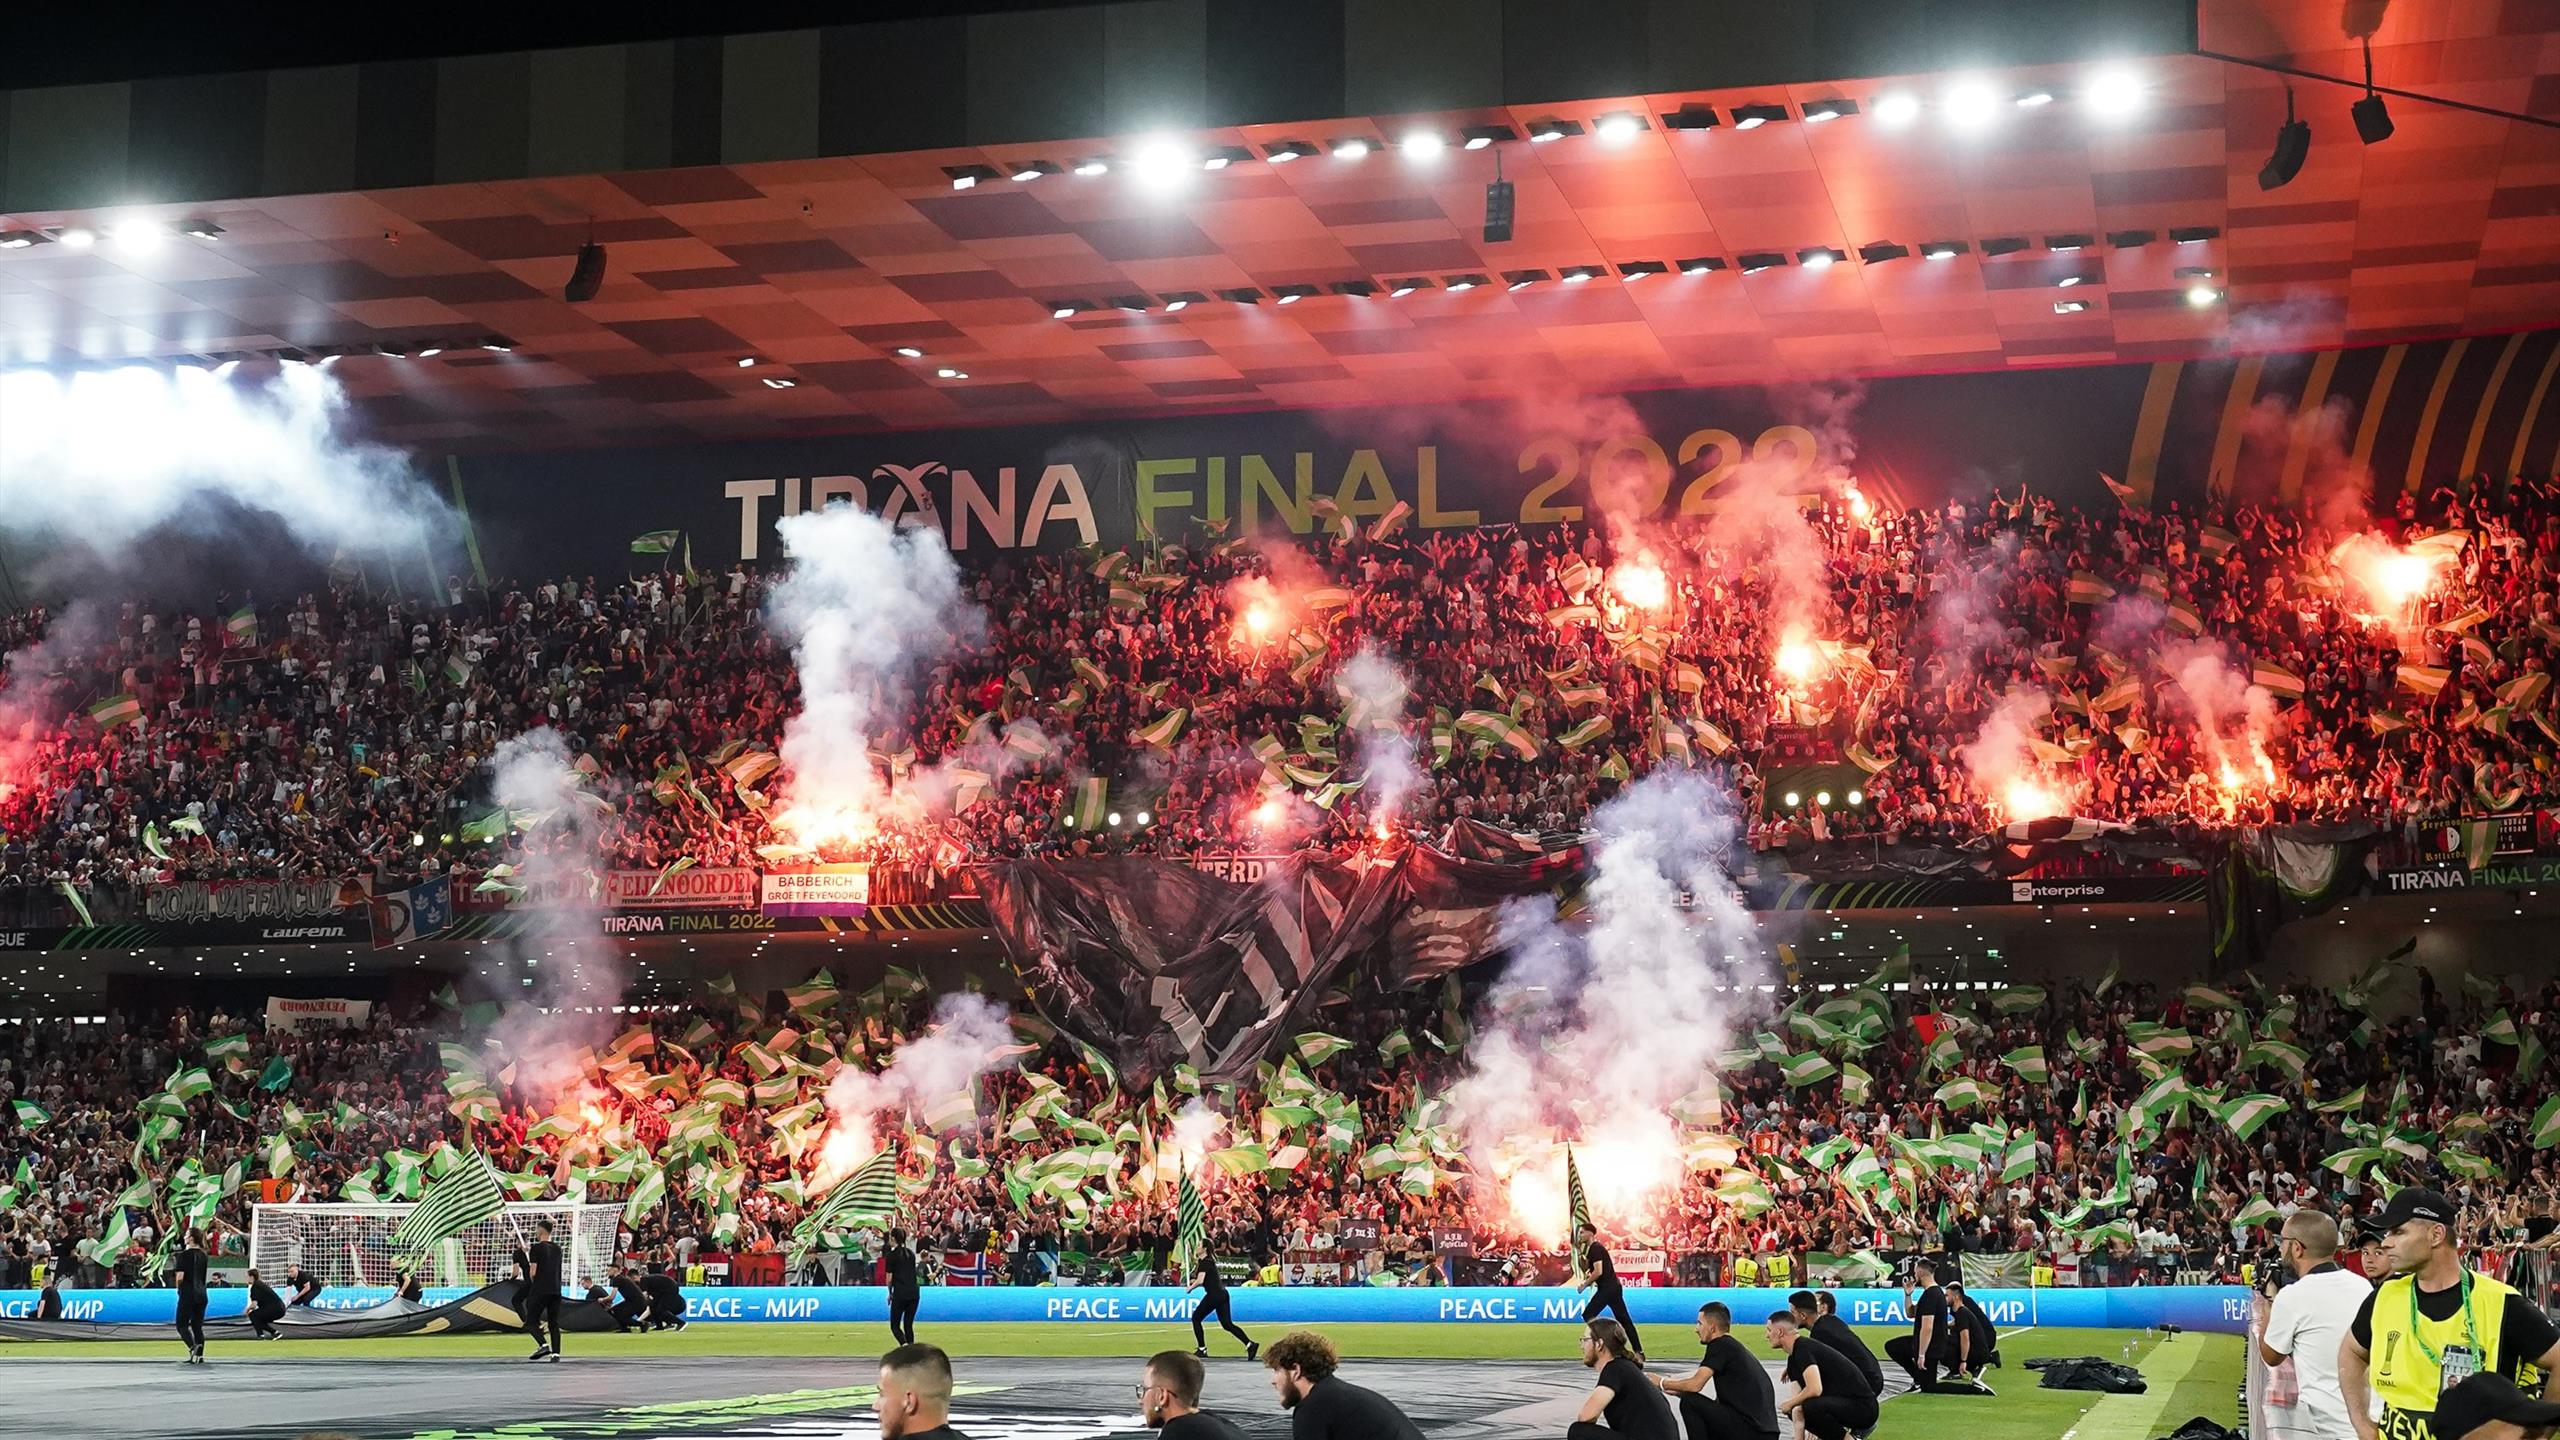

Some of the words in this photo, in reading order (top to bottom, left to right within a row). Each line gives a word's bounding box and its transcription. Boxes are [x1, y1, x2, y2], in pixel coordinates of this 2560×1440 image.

[1136, 446, 1480, 542] FINAL
[1518, 425, 1822, 524] 2022
[2421, 818, 2466, 830] Feyenoo
[2425, 851, 2466, 862] Rotterda
[778, 876, 853, 887] BABBERICH
[2388, 870, 2465, 890] TIRANA
[2471, 866, 2537, 886] FINAL
[150, 881, 211, 924] ROMA
[216, 878, 345, 922] VAFFANCUL
[768, 891, 800, 900] GROET
[803, 891, 862, 900] FEYENOORD
[602, 915, 664, 933] TIRANA
[669, 915, 724, 931] FINAL
[729, 914, 776, 930] 2022
[686, 1298, 742, 1318] EACE
[764, 1298, 820, 1318] МИР
[1048, 1298, 1121, 1319] PEACE
[1440, 1298, 1517, 1320] PEACE
[1543, 1298, 1585, 1319] МИ
[1854, 1300, 1915, 1322] PEA
[2223, 1298, 2249, 1321] PEA
[2376, 1379, 2397, 1388] FINAL
